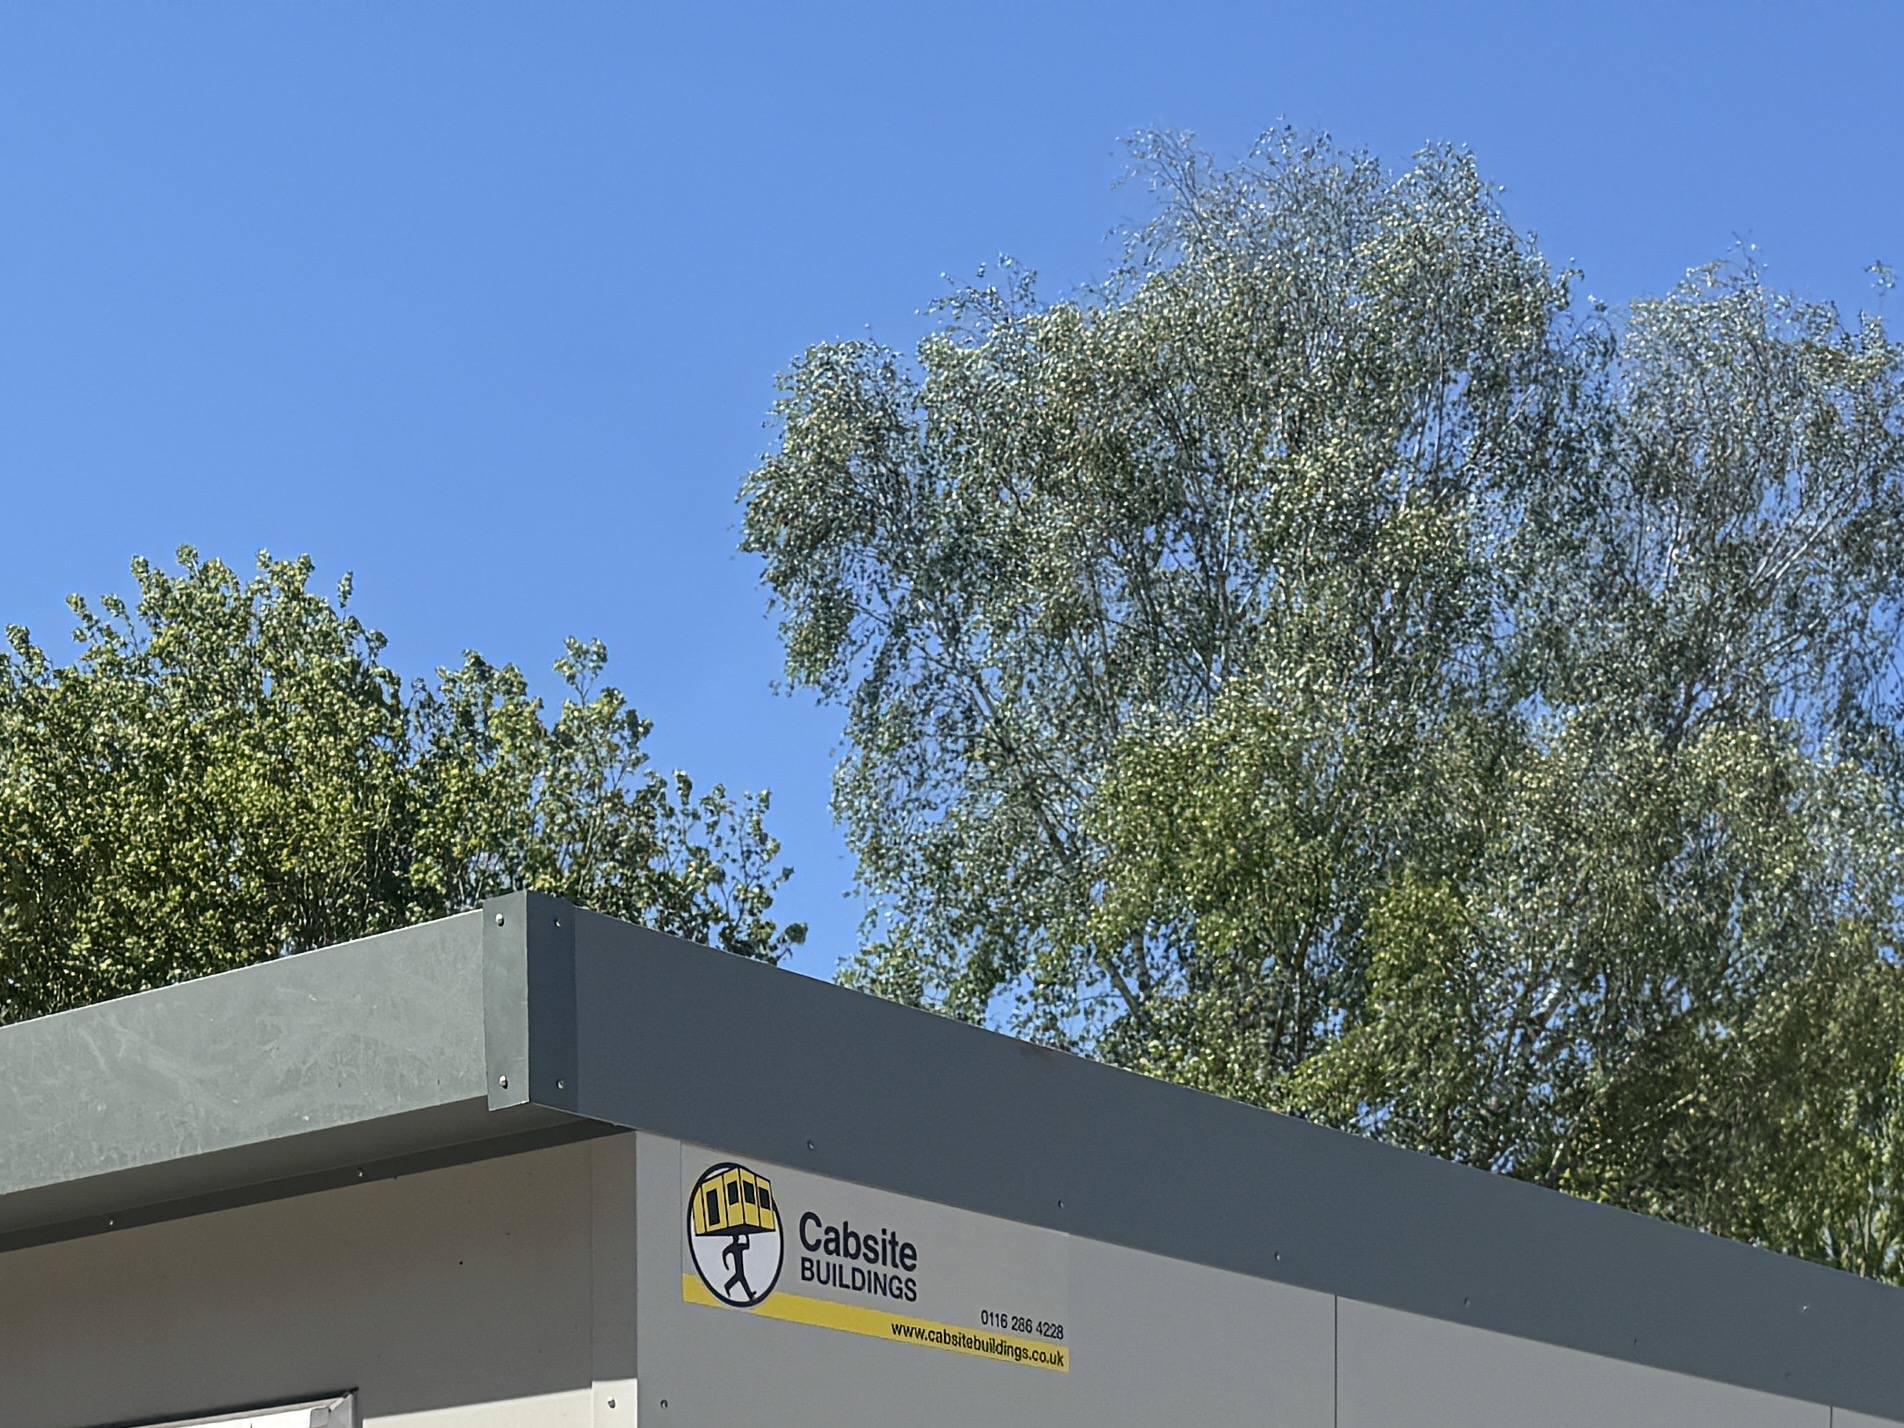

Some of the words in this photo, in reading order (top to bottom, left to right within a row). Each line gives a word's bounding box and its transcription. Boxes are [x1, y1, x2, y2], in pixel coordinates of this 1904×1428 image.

[799, 1211, 917, 1272] Cabsite
[800, 1256, 917, 1302] BUILDINGS
[891, 1322, 1064, 1368] www.cabsitebuildings.co.uk
[981, 1309, 1007, 1329] 0116
[1011, 1315, 1033, 1334] 286
[1036, 1320, 1064, 1340] 4228
